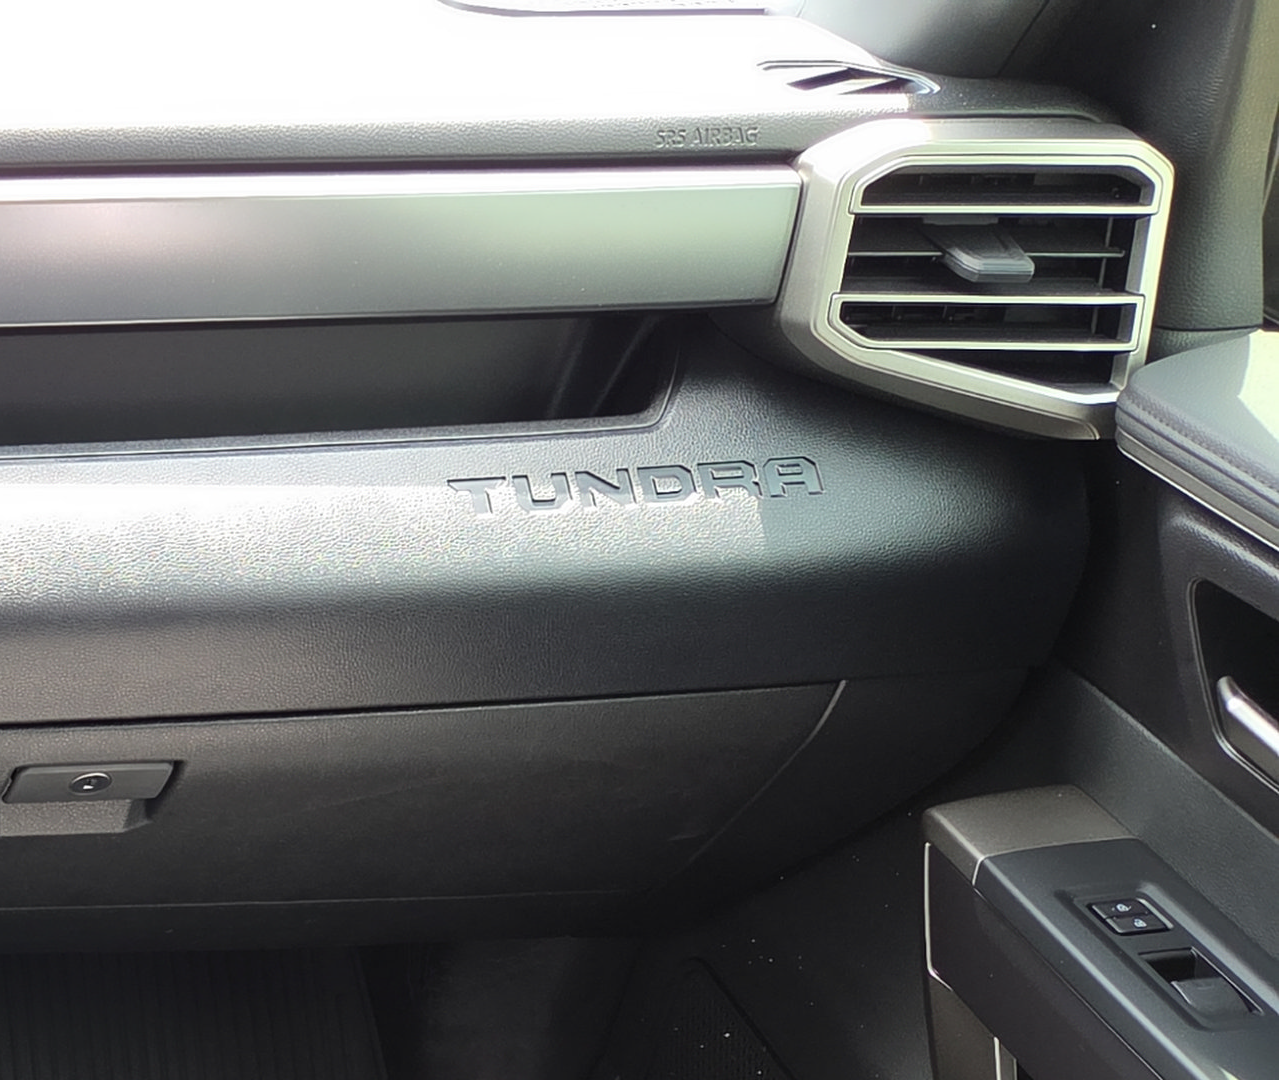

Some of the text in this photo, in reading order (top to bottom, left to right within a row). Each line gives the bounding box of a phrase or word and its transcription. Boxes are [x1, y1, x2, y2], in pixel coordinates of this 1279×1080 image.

[655, 126, 761, 149] SRS AIRBAG
[446, 456, 825, 514] TUNDRA
